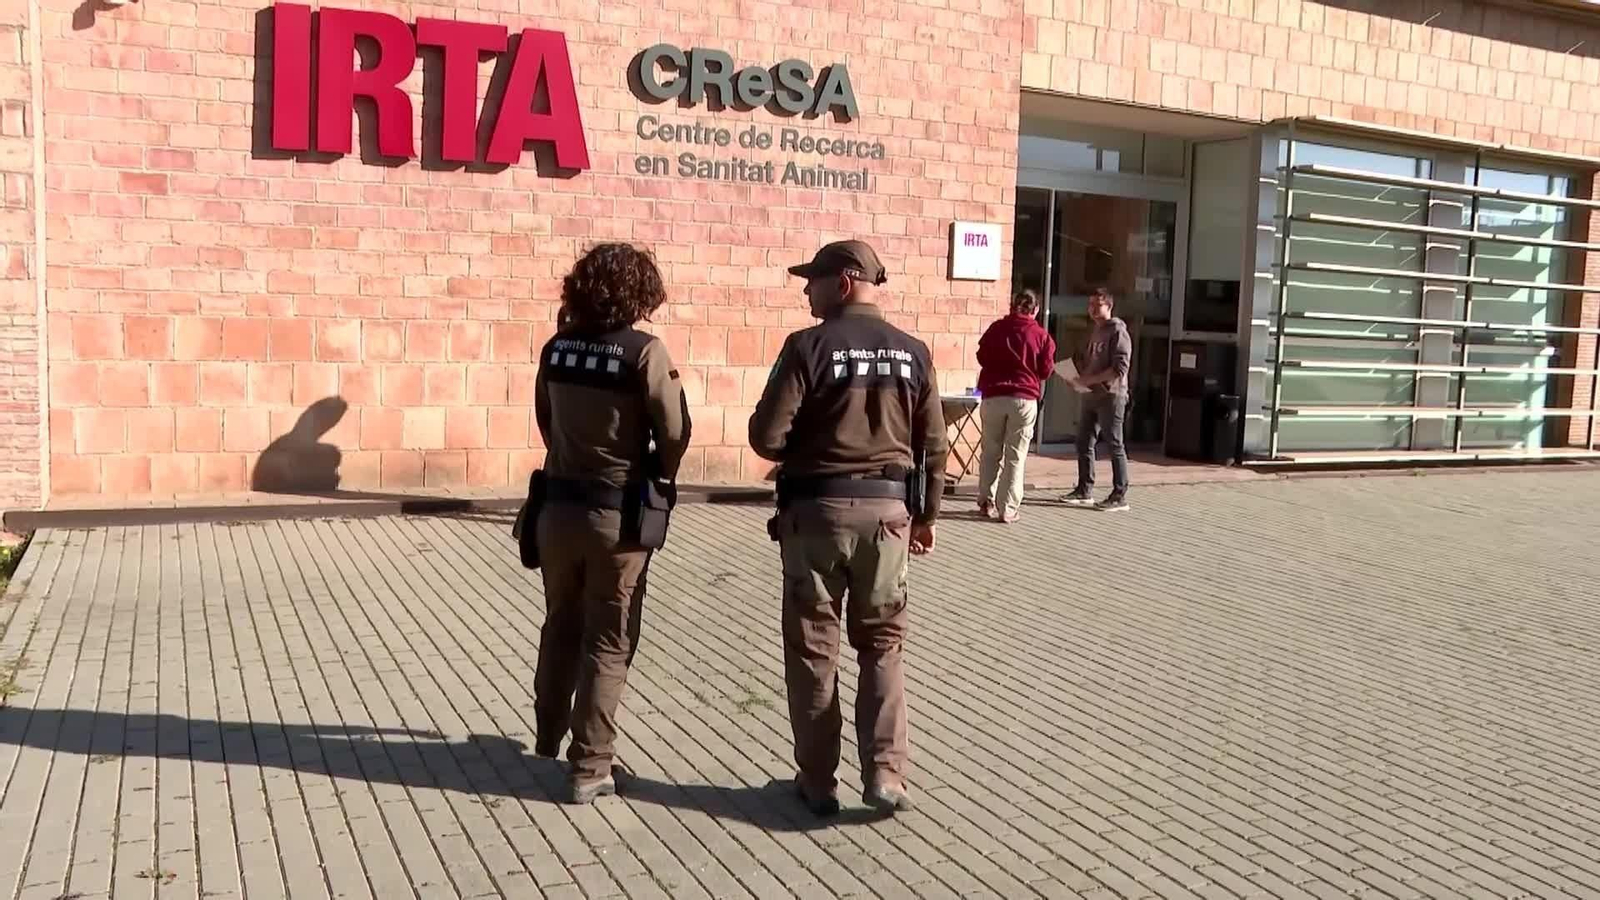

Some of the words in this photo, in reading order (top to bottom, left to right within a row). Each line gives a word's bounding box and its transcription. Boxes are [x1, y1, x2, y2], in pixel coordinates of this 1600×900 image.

[271, 2, 590, 170] IRTA
[641, 43, 859, 121] CReSA
[636, 115, 730, 147] Centre
[739, 125, 772, 149] de
[780, 128, 885, 160] Recerca
[635, 153, 669, 175] en
[678, 152, 774, 183] Sanitat
[781, 160, 868, 191] Animal
[964, 232, 988, 247] IRTA
[554, 339, 586, 351] agents
[588, 342, 624, 356] rurals
[832, 349, 875, 361] agents
[877, 349, 912, 362] rurals
